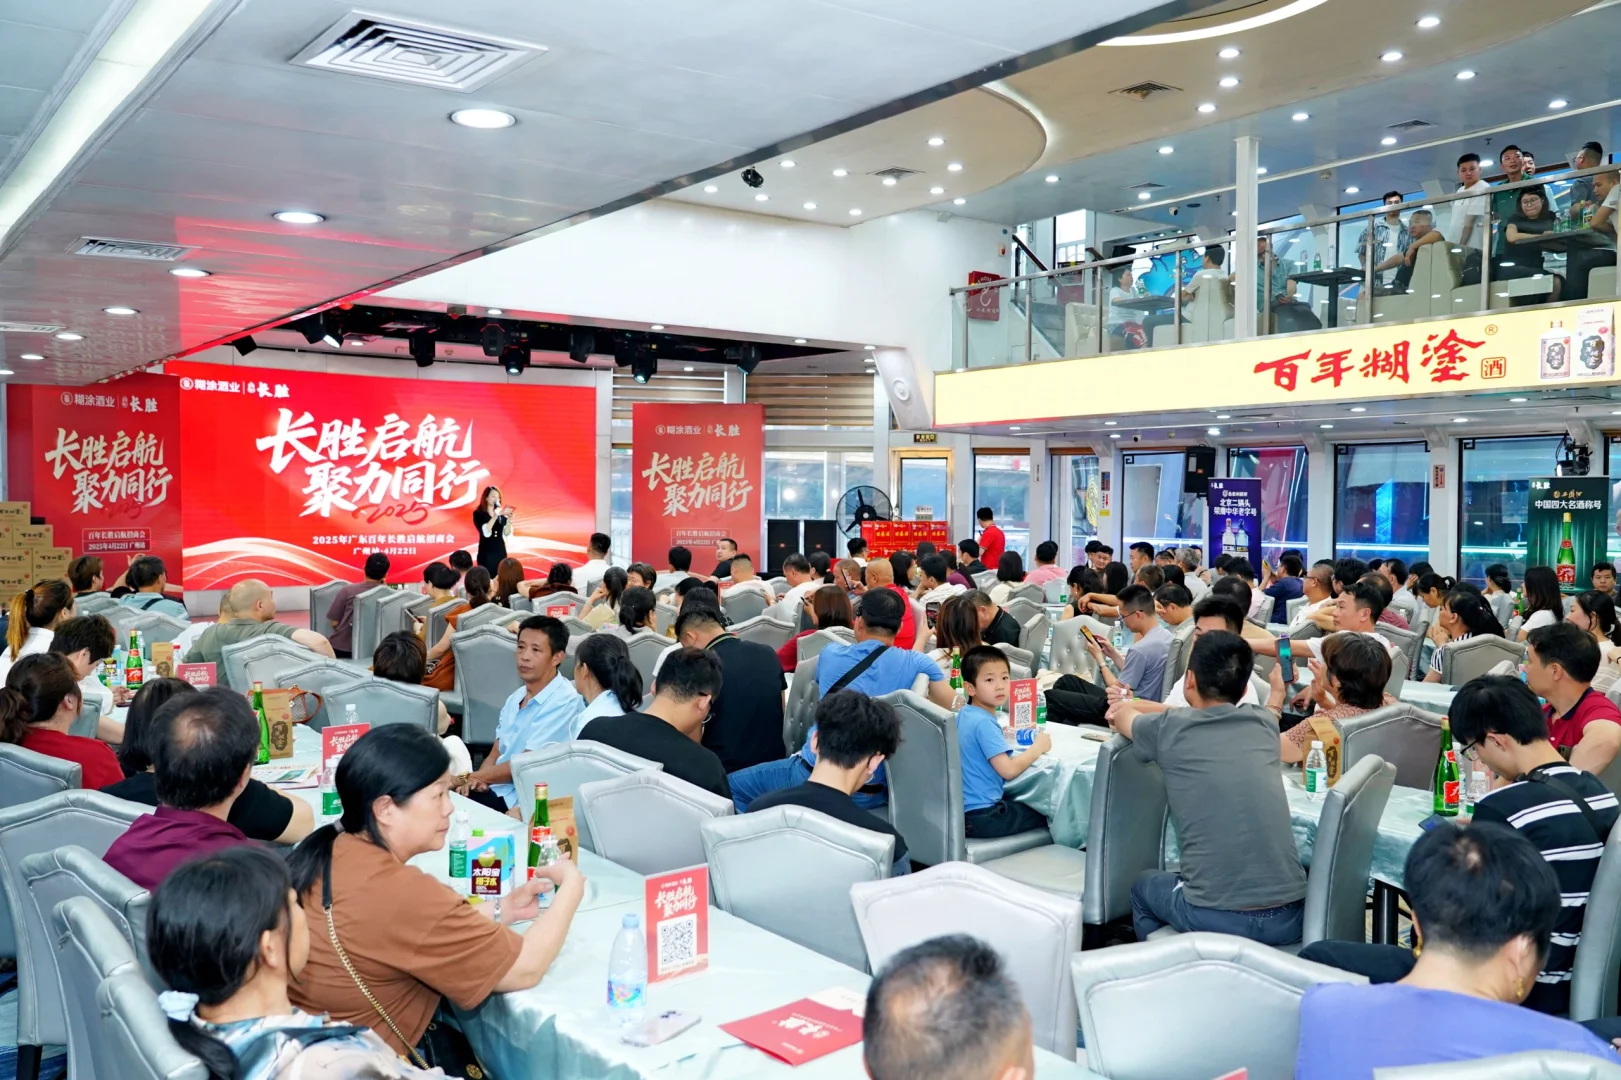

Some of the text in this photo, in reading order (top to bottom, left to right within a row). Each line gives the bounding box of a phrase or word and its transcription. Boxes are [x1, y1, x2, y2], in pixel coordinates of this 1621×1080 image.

[1253, 328, 1505, 392] 百年糊塗 酒
[74, 393, 115, 408] 糊涂酒业
[130, 395, 159, 413] 长胜
[194, 378, 241, 393] 糊涂酒业
[256, 408, 474, 474] 长胜启航
[666, 425, 702, 435] 糊涂酒业
[44, 427, 164, 480] 长胜启航
[641, 451, 746, 492] 长胜启航
[71, 467, 173, 515] 聚力同行
[299, 459, 491, 518] 聚力同行
[661, 480, 754, 517] 聚力同行
[1535, 500, 1602, 510] 中国四大名酒称号
[354, 502, 428, 526] 2025
[312, 534, 455, 544] 2025年广东百年长胜启航招商会
